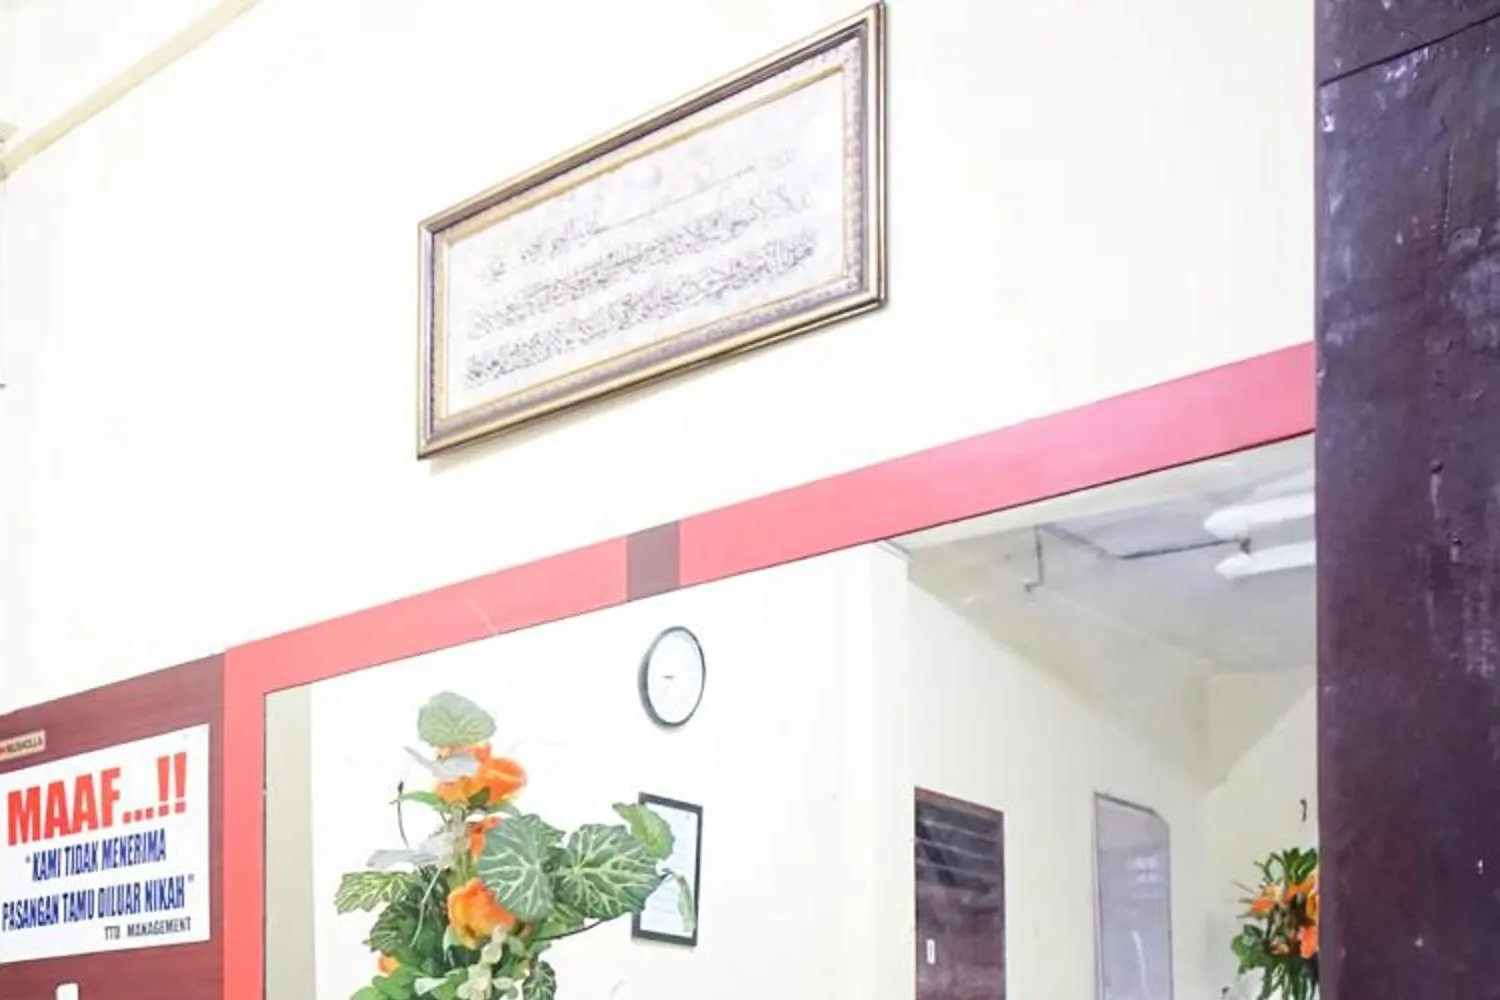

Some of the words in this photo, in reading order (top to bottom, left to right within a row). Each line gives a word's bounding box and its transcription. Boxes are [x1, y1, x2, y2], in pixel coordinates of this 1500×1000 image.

[64, 840, 99, 877] TIDAK
[102, 828, 167, 870] MENERIMA
[2, 894, 59, 932] PASANGAN
[62, 888, 95, 923] TAMU
[99, 882, 140, 918] DILUAR
[127, 917, 192, 938] MANAGEMENT
